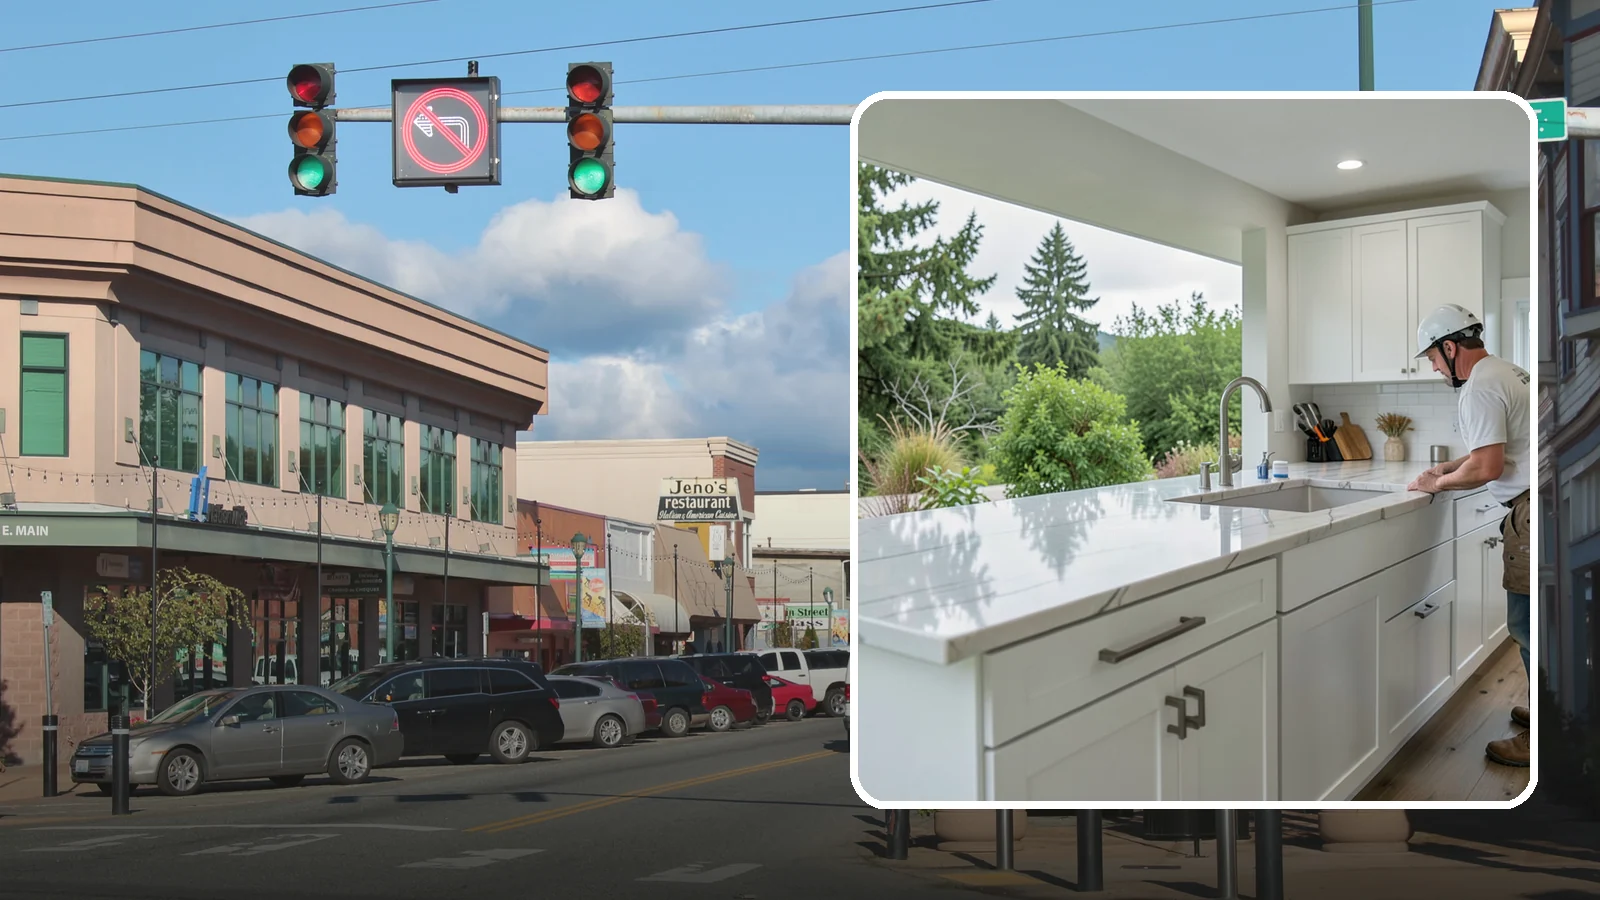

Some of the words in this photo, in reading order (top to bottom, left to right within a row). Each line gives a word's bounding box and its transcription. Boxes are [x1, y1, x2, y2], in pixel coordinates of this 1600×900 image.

[670, 480, 727, 495] Jeno's
[665, 496, 731, 509] restaurant
[659, 510, 681, 519] Italian
[686, 510, 714, 519] American
[715, 509, 737, 519] Cuisine
[2, 525, 13, 536] E.
[16, 525, 49, 536] MAIN
[797, 607, 828, 617] Street
